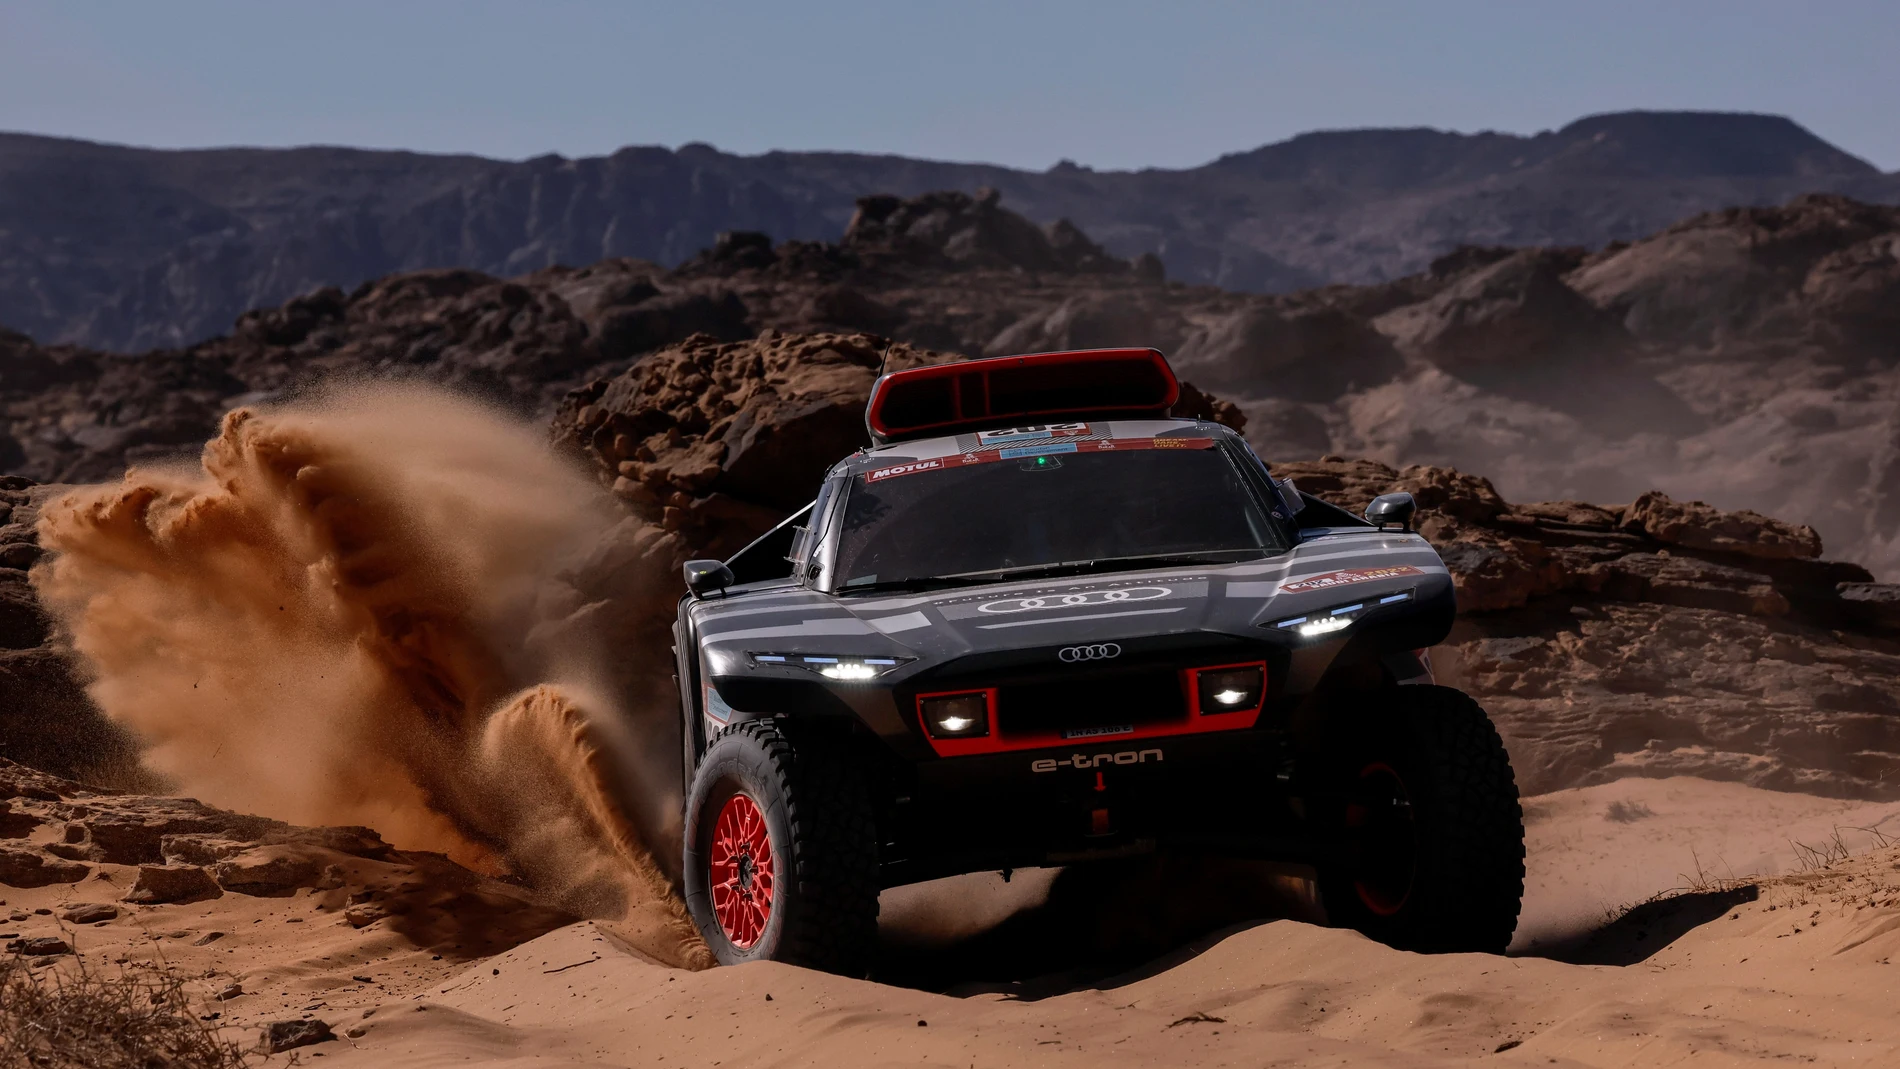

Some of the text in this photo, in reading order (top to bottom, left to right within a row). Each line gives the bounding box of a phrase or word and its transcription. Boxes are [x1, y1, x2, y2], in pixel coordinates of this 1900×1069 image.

[872, 460, 939, 479] MOTUL
[1352, 572, 1399, 582] ARABIA
[1364, 566, 1410, 576] 2022
[1031, 748, 1164, 773] e-tron
